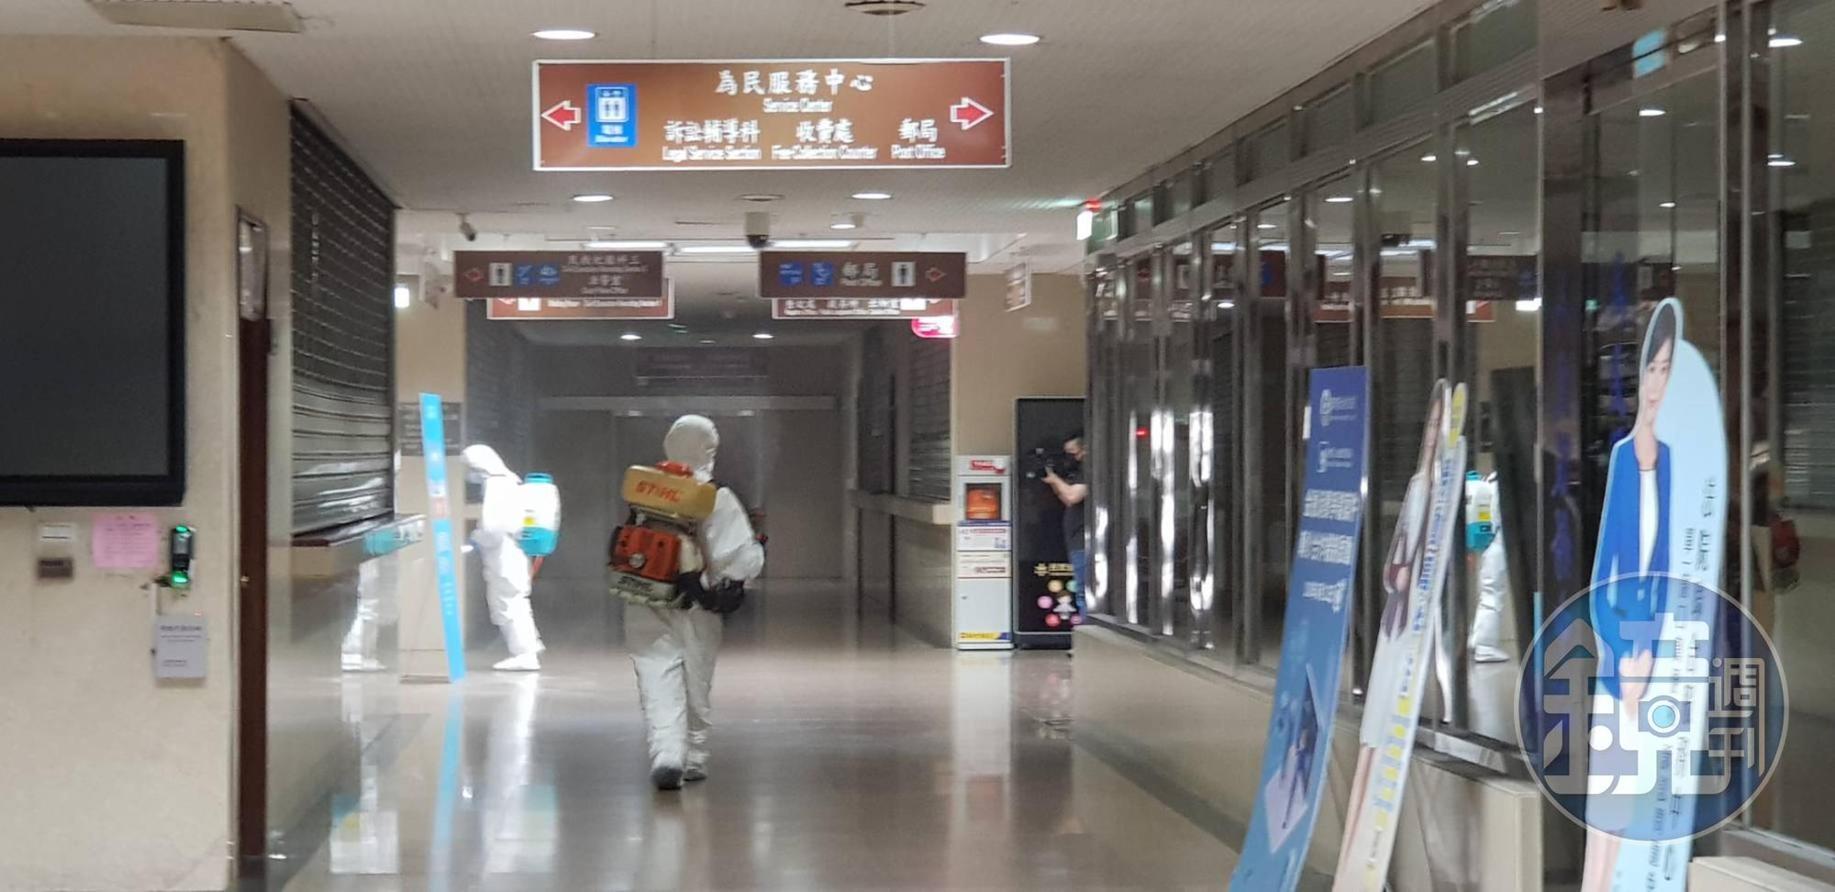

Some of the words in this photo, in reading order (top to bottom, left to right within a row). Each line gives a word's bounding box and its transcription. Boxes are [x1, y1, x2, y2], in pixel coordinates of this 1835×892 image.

[715, 68, 873, 96] 為民服務中心
[763, 98, 799, 112] Service
[800, 98, 832, 112] Center
[898, 118, 938, 143] 郵局
[662, 145, 687, 162] Legal
[891, 144, 914, 159] Post
[915, 144, 946, 159] Office
